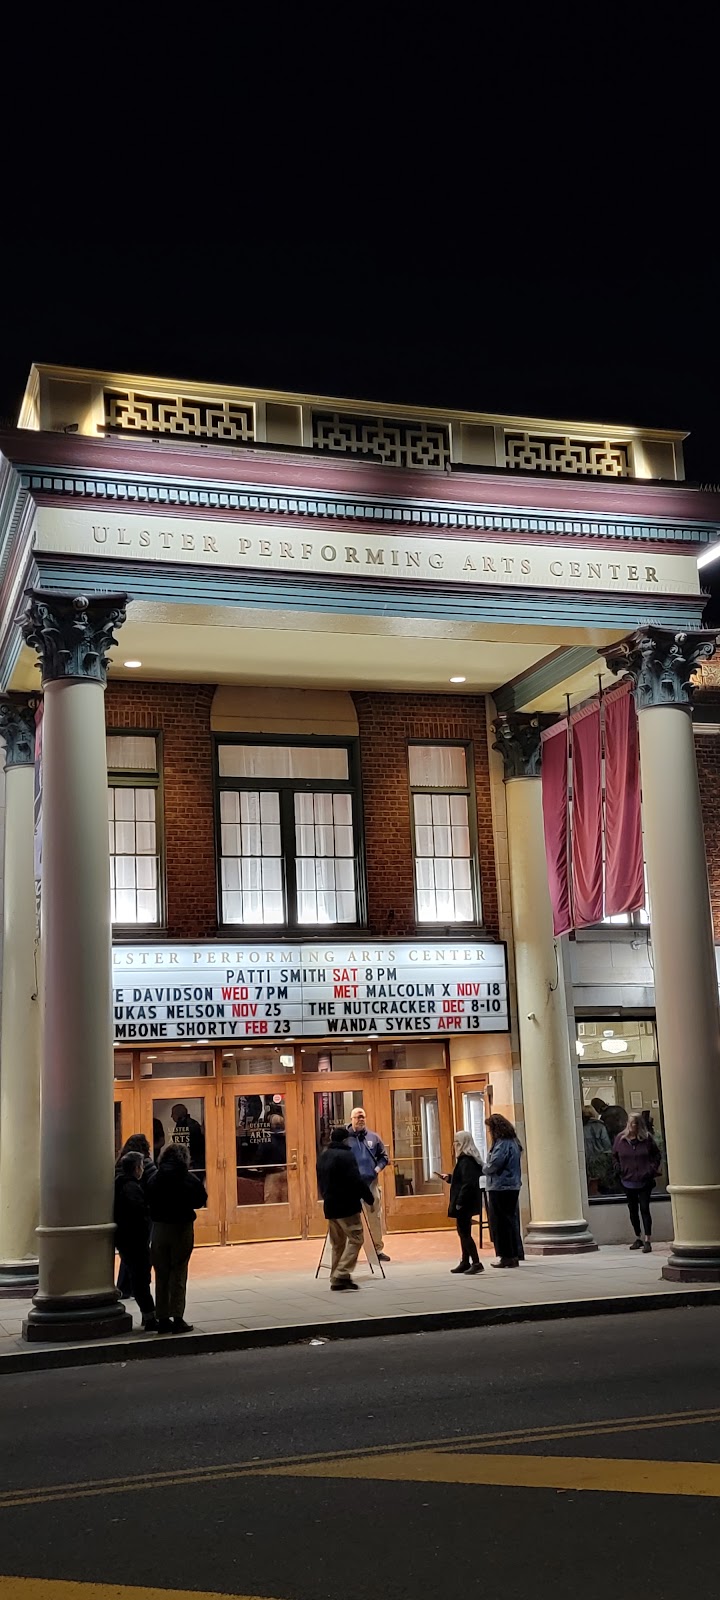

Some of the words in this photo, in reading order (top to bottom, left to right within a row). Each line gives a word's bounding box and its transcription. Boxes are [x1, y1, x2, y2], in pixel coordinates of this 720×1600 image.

[92, 526, 218, 553] ULSTER
[239, 538, 444, 569] PERFORMING
[463, 555, 531, 574] ARTS
[550, 561, 659, 582] CENTER
[113, 952, 179, 965] LSTER
[193, 951, 335, 963] PERFORMING
[347, 950, 396, 961] ARTS
[408, 949, 486, 961] CENTER
[226, 969, 270, 983] PATTI
[280, 969, 326, 983] SMITH
[333, 968, 358, 982] SAT
[133, 987, 213, 1002] DAVIDSON
[221, 986, 249, 1000] WED
[333, 985, 358, 998] MET
[366, 983, 435, 997] MALCOLM
[442, 983, 451, 996] X
[456, 983, 480, 996] NOV
[487, 982, 500, 996] 18
[114, 1005, 157, 1019] UKAS
[166, 1004, 225, 1018] NELSON
[232, 1003, 258, 1017] NOV
[265, 1003, 281, 1016] 25
[309, 1002, 335, 1015] THE
[344, 1000, 436, 1015] NUTCRACKER
[442, 1000, 465, 1013] DEC
[471, 999, 501, 1012] 8-10
[115, 1023, 167, 1038] MBONE
[176, 1021, 238, 1036] SHORTY
[245, 1020, 268, 1034] FEB
[274, 1020, 291, 1033] 23
[327, 1018, 377, 1032] WANDA
[386, 1016, 431, 1031] SYKES
[437, 1016, 462, 1029] APR
[467, 1015, 480, 1029] 13
[169, 1135, 190, 1143] ARTS
[250, 1131, 272, 1139] ARTS
